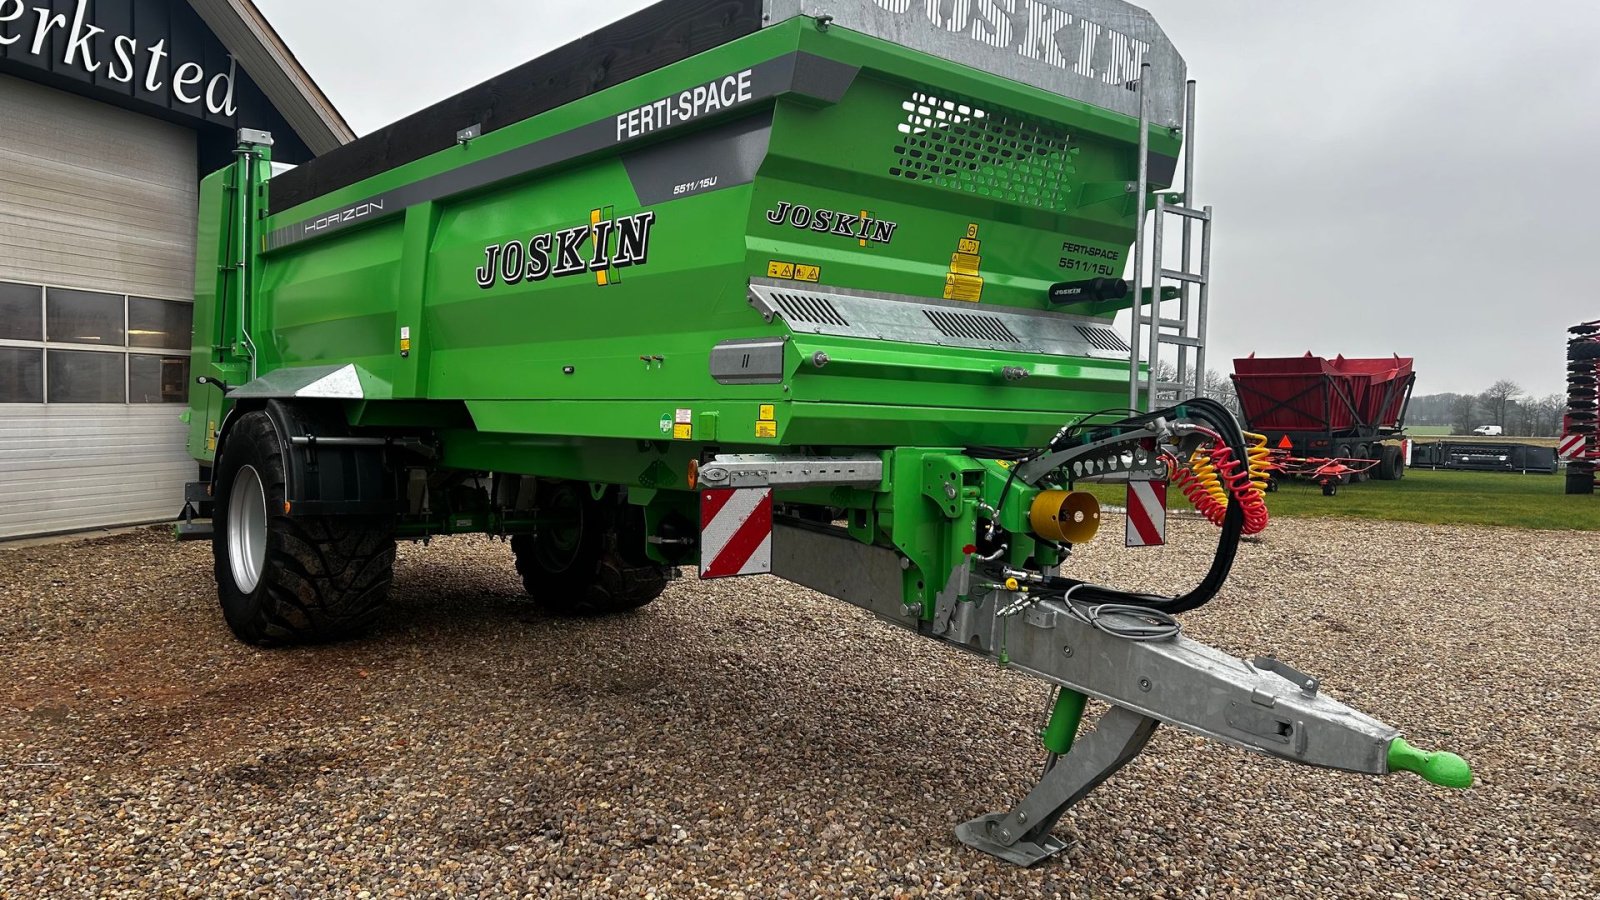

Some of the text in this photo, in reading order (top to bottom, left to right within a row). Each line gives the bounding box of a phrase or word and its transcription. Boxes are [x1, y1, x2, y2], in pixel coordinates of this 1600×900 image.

[617, 69, 752, 141] FERTI-SPACE
[673, 176, 718, 195] 5511/15U
[304, 199, 384, 234] HORIZON
[766, 201, 897, 243] JOSKIN
[476, 211, 655, 288] JOSKIN
[1062, 242, 1119, 260] FERTI-SPACE
[1059, 257, 1114, 276] 5511/15U
[1054, 287, 1082, 295] JOSKIN
